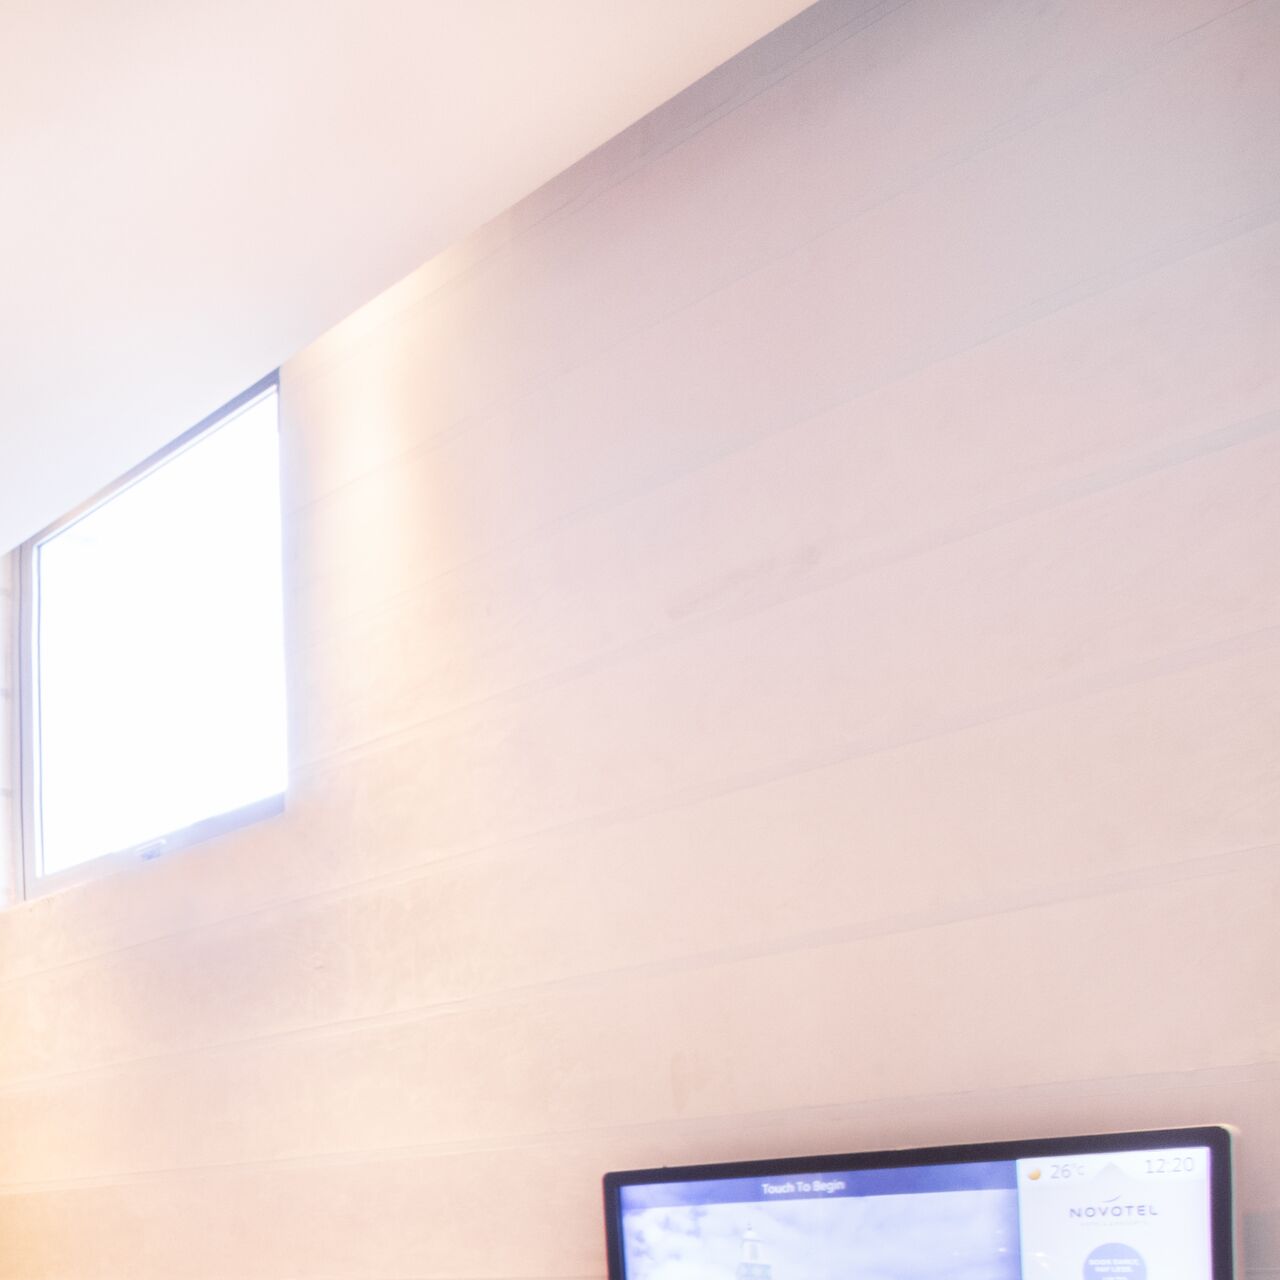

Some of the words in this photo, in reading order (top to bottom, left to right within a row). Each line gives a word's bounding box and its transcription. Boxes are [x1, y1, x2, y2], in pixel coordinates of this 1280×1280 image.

[761, 1182, 795, 1195] Touch
[796, 1181, 811, 1193] To
[812, 1179, 846, 1194] Begin
[1068, 1205, 1159, 1219] NOVOTEL
